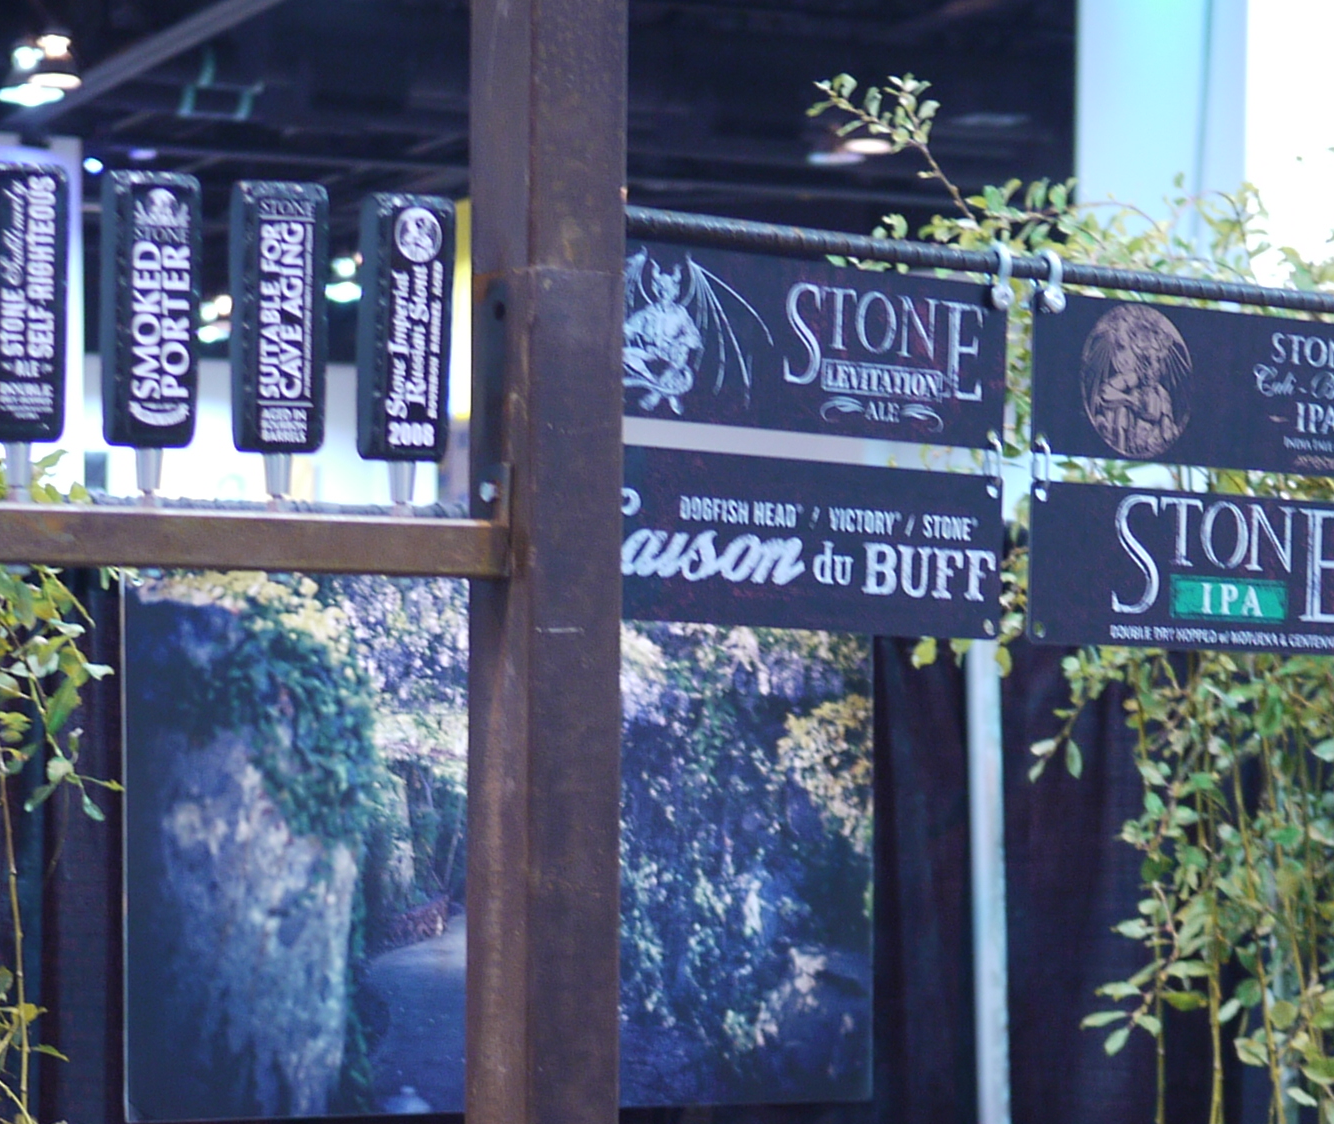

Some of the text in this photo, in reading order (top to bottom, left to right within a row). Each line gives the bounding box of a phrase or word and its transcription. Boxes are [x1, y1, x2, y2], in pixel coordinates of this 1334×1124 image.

[0, 286, 26, 357] STONE
[131, 239, 162, 399] SMOKED
[160, 244, 190, 398] PORTER
[259, 221, 282, 398] SUITABLE FOR
[279, 221, 304, 398] CAVE AGING
[384, 268, 412, 419] Stone Imperial
[405, 263, 430, 407] Russian Stout
[783, 282, 986, 402] STONE
[387, 422, 434, 448] 2008
[825, 362, 943, 399] LEVITATION
[621, 488, 997, 602] aison du BUFF
[679, 495, 749, 525] DOGFISH
[752, 501, 797, 528] HEAD
[828, 506, 893, 537] VICTORY
[921, 514, 971, 542] STONE
[1201, 582, 1265, 618] IPA
